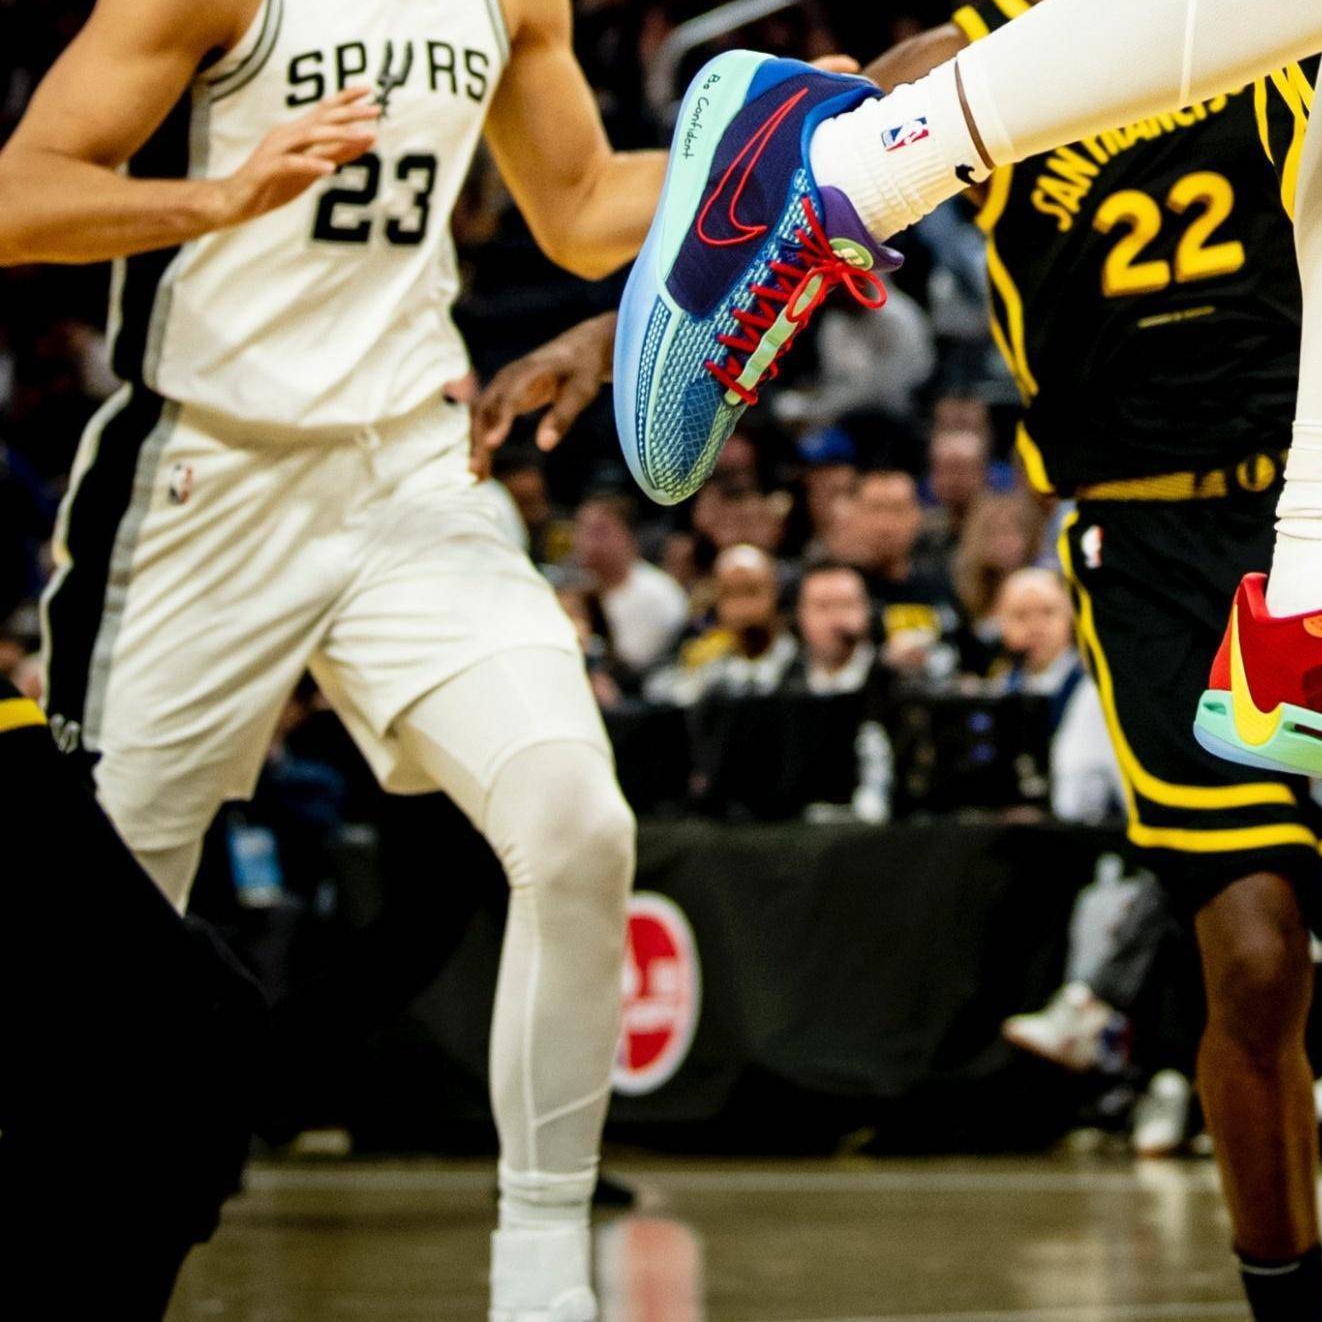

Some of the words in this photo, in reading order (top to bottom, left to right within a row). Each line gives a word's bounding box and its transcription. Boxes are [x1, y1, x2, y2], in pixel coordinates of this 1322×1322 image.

[284, 39, 491, 119] SPURS
[703, 73, 721, 90] Be
[682, 96, 711, 160] Confident
[311, 150, 438, 245] 23
[1030, 144, 1101, 233] SAN
[1091, 168, 1247, 299] 22
